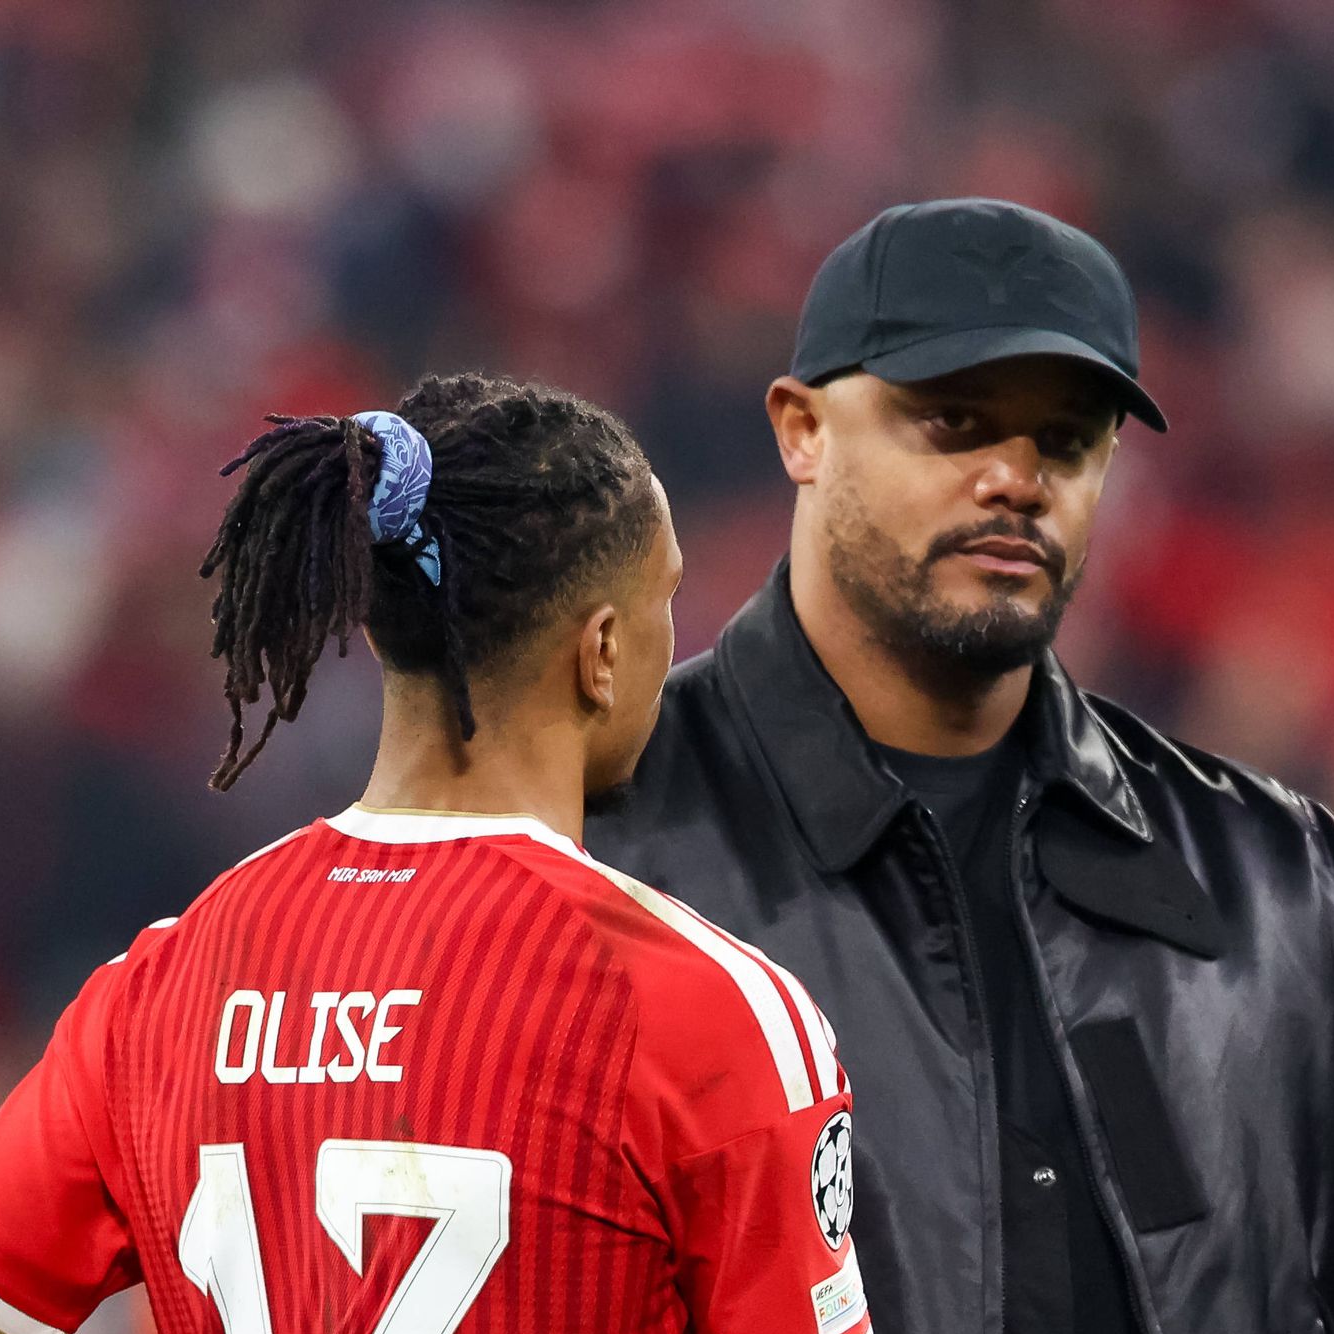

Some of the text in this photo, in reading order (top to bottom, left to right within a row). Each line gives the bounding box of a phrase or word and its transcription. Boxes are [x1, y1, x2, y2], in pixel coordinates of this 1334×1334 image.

[327, 866, 417, 883] MIA SAN MIA
[214, 989, 423, 1084] OLISE
[816, 1284, 834, 1301] UEFA
[818, 1291, 856, 1321] FOUN
